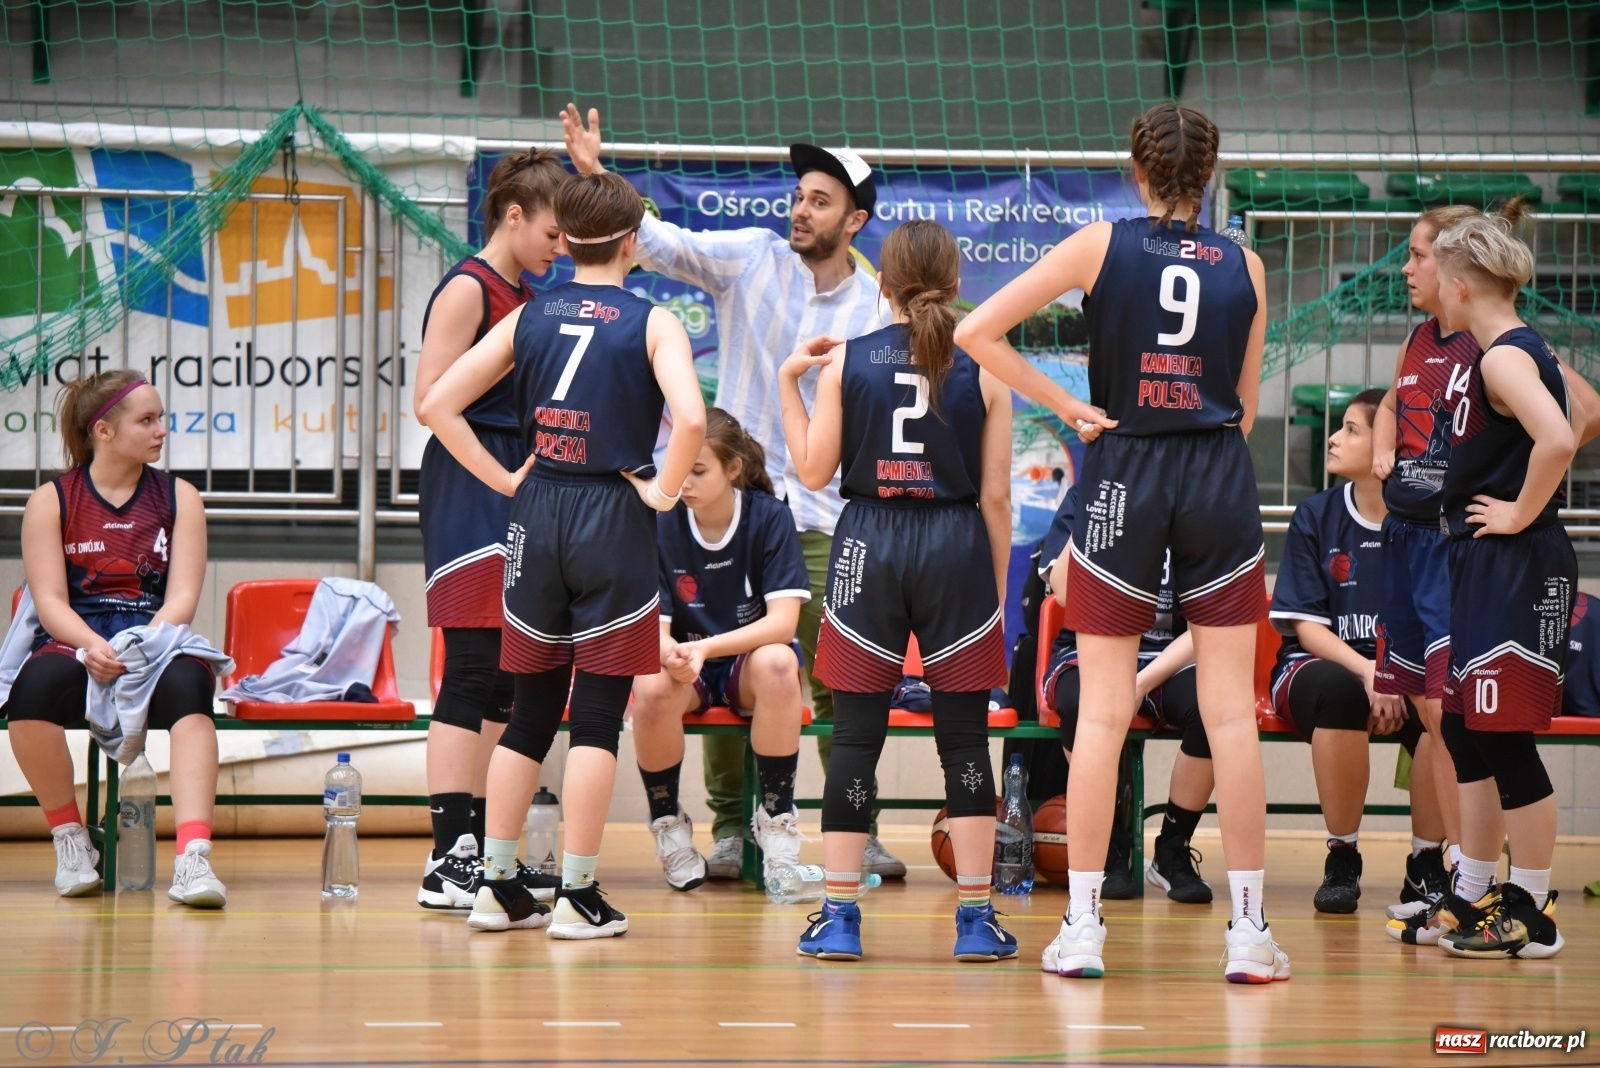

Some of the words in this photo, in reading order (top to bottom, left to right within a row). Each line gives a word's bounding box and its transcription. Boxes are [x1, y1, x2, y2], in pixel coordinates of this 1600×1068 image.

[1157, 264, 1200, 347] 9
[551, 323, 595, 401] 7
[1140, 352, 1202, 377] KAMIENICA
[1138, 379, 1203, 410] POLSKA
[535, 406, 590, 432] KAMIENICA
[892, 372, 930, 454] 2
[535, 430, 587, 465] POLSKA
[877, 459, 934, 482] KAMIENICA
[154, 527, 168, 561] 4
[1475, 678, 1499, 714] 10
